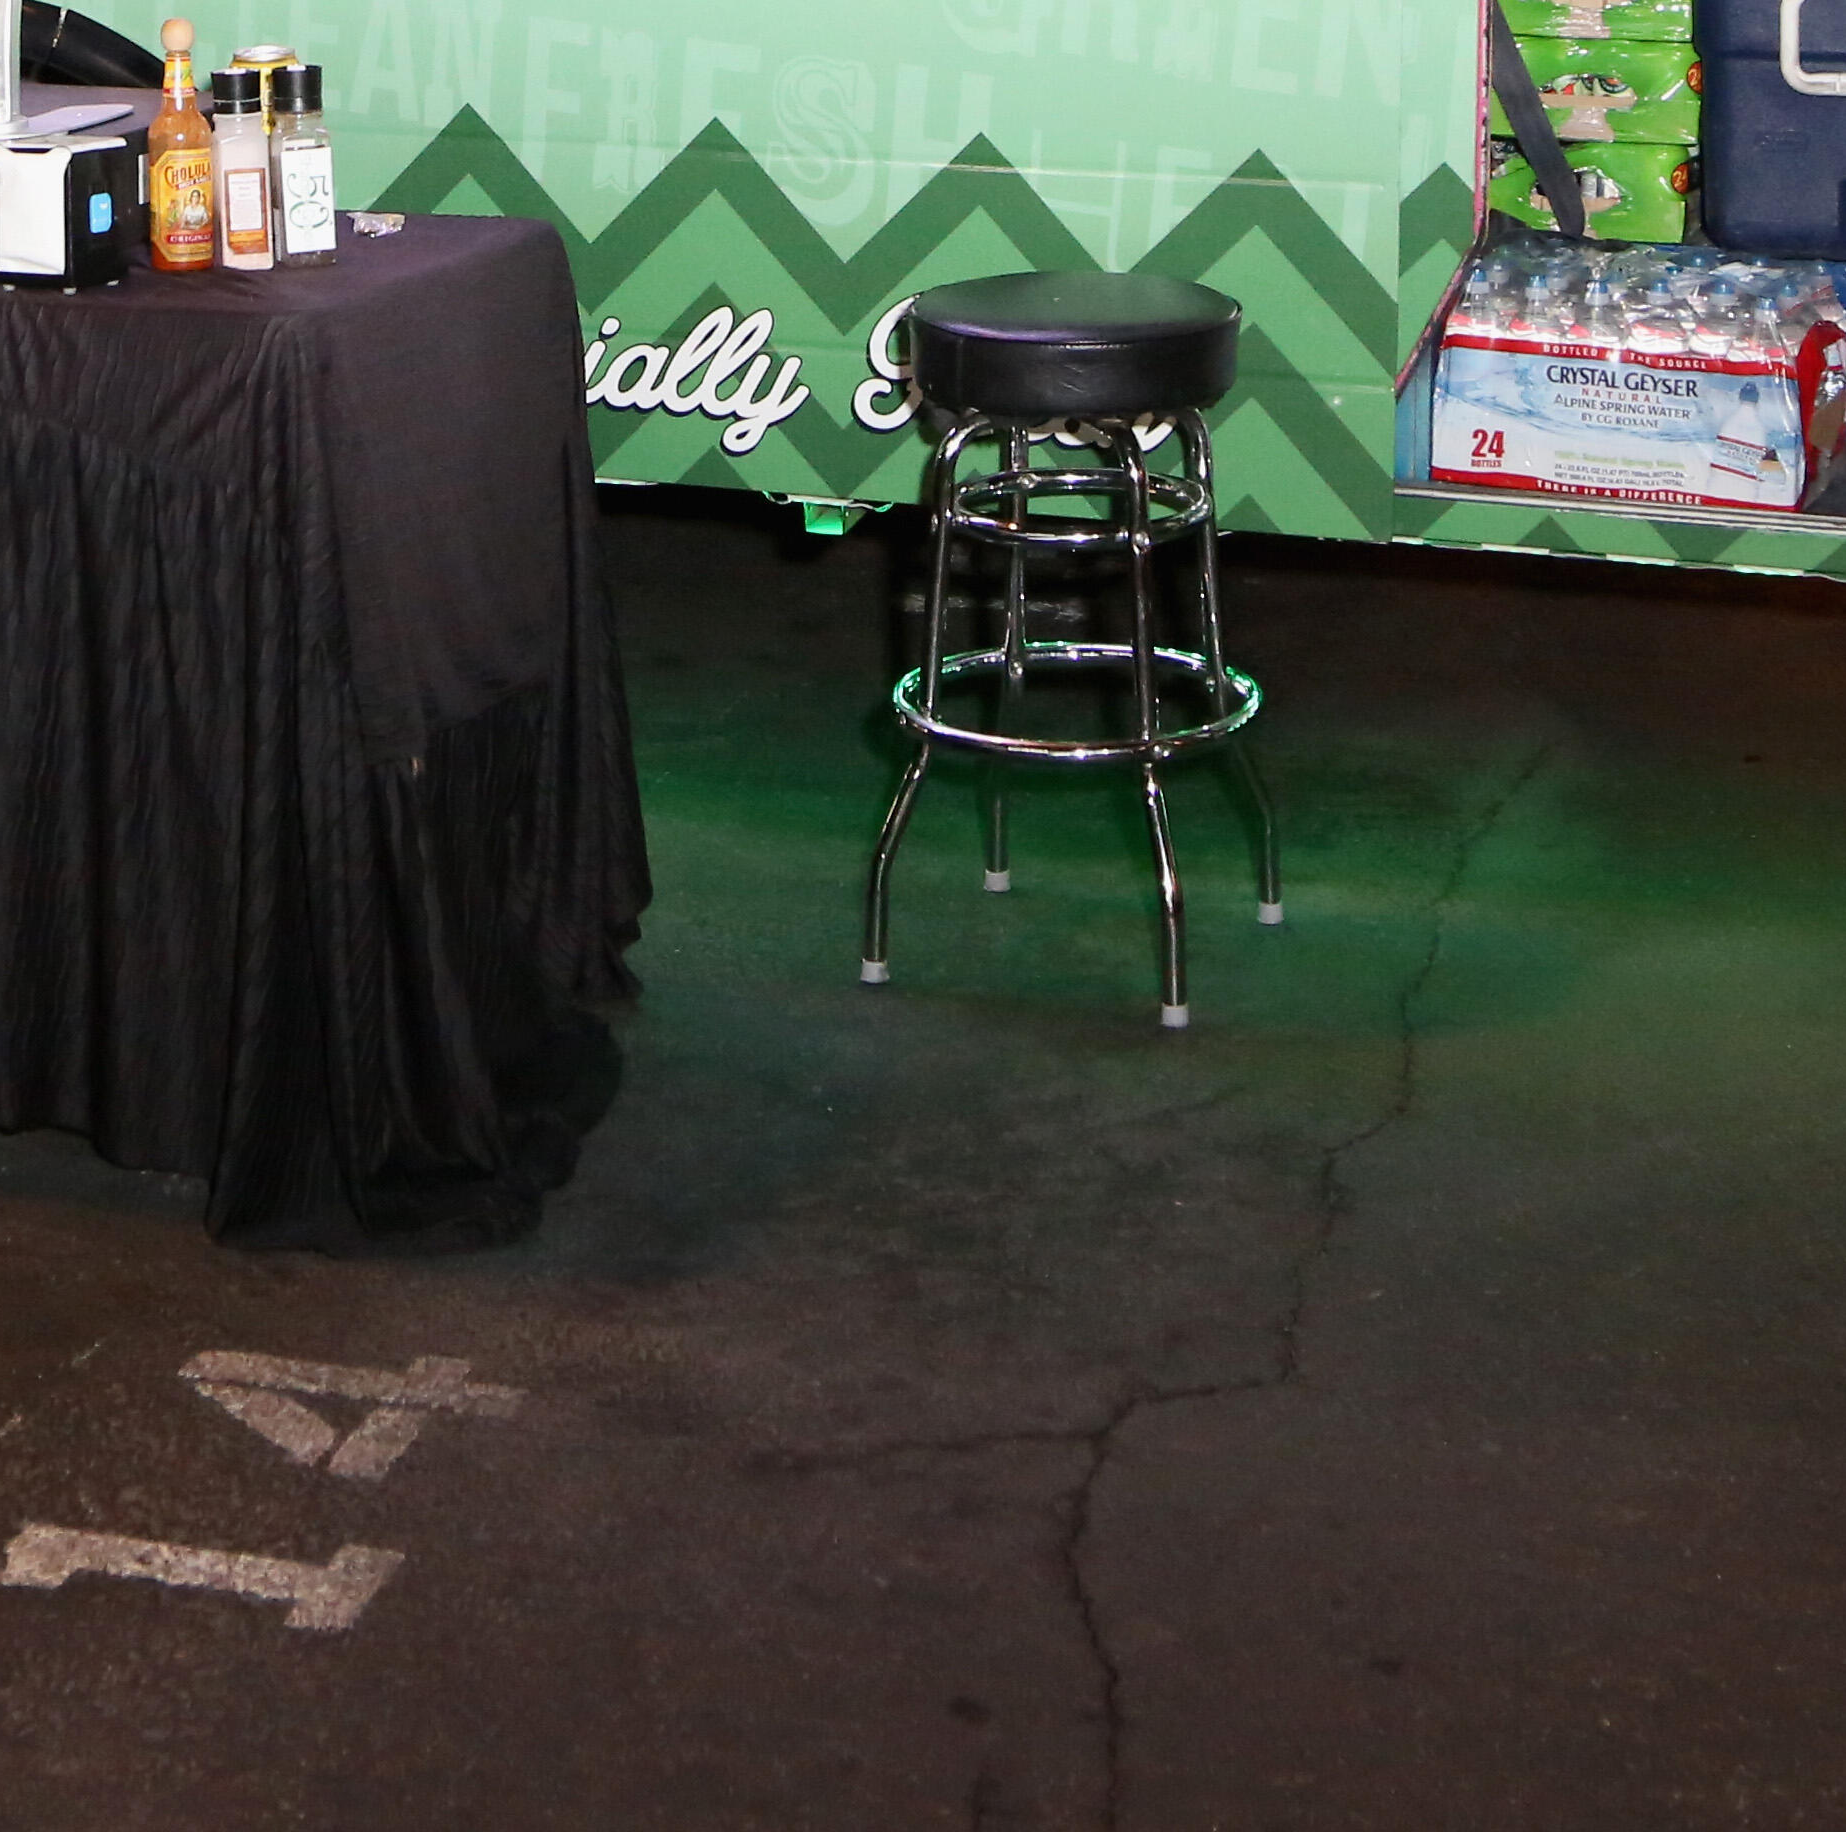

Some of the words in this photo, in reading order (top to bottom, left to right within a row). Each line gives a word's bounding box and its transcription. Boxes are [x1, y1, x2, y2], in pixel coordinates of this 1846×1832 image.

[1546, 364, 1620, 390] CRYSTAL
[1624, 371, 1699, 398] GEYSER
[1581, 388, 1662, 404] NATURAL
[1600, 399, 1646, 415] SPRING
[1648, 404, 1691, 420] WATER
[1471, 428, 1505, 459] 24
[0, 1349, 525, 1630] 14
